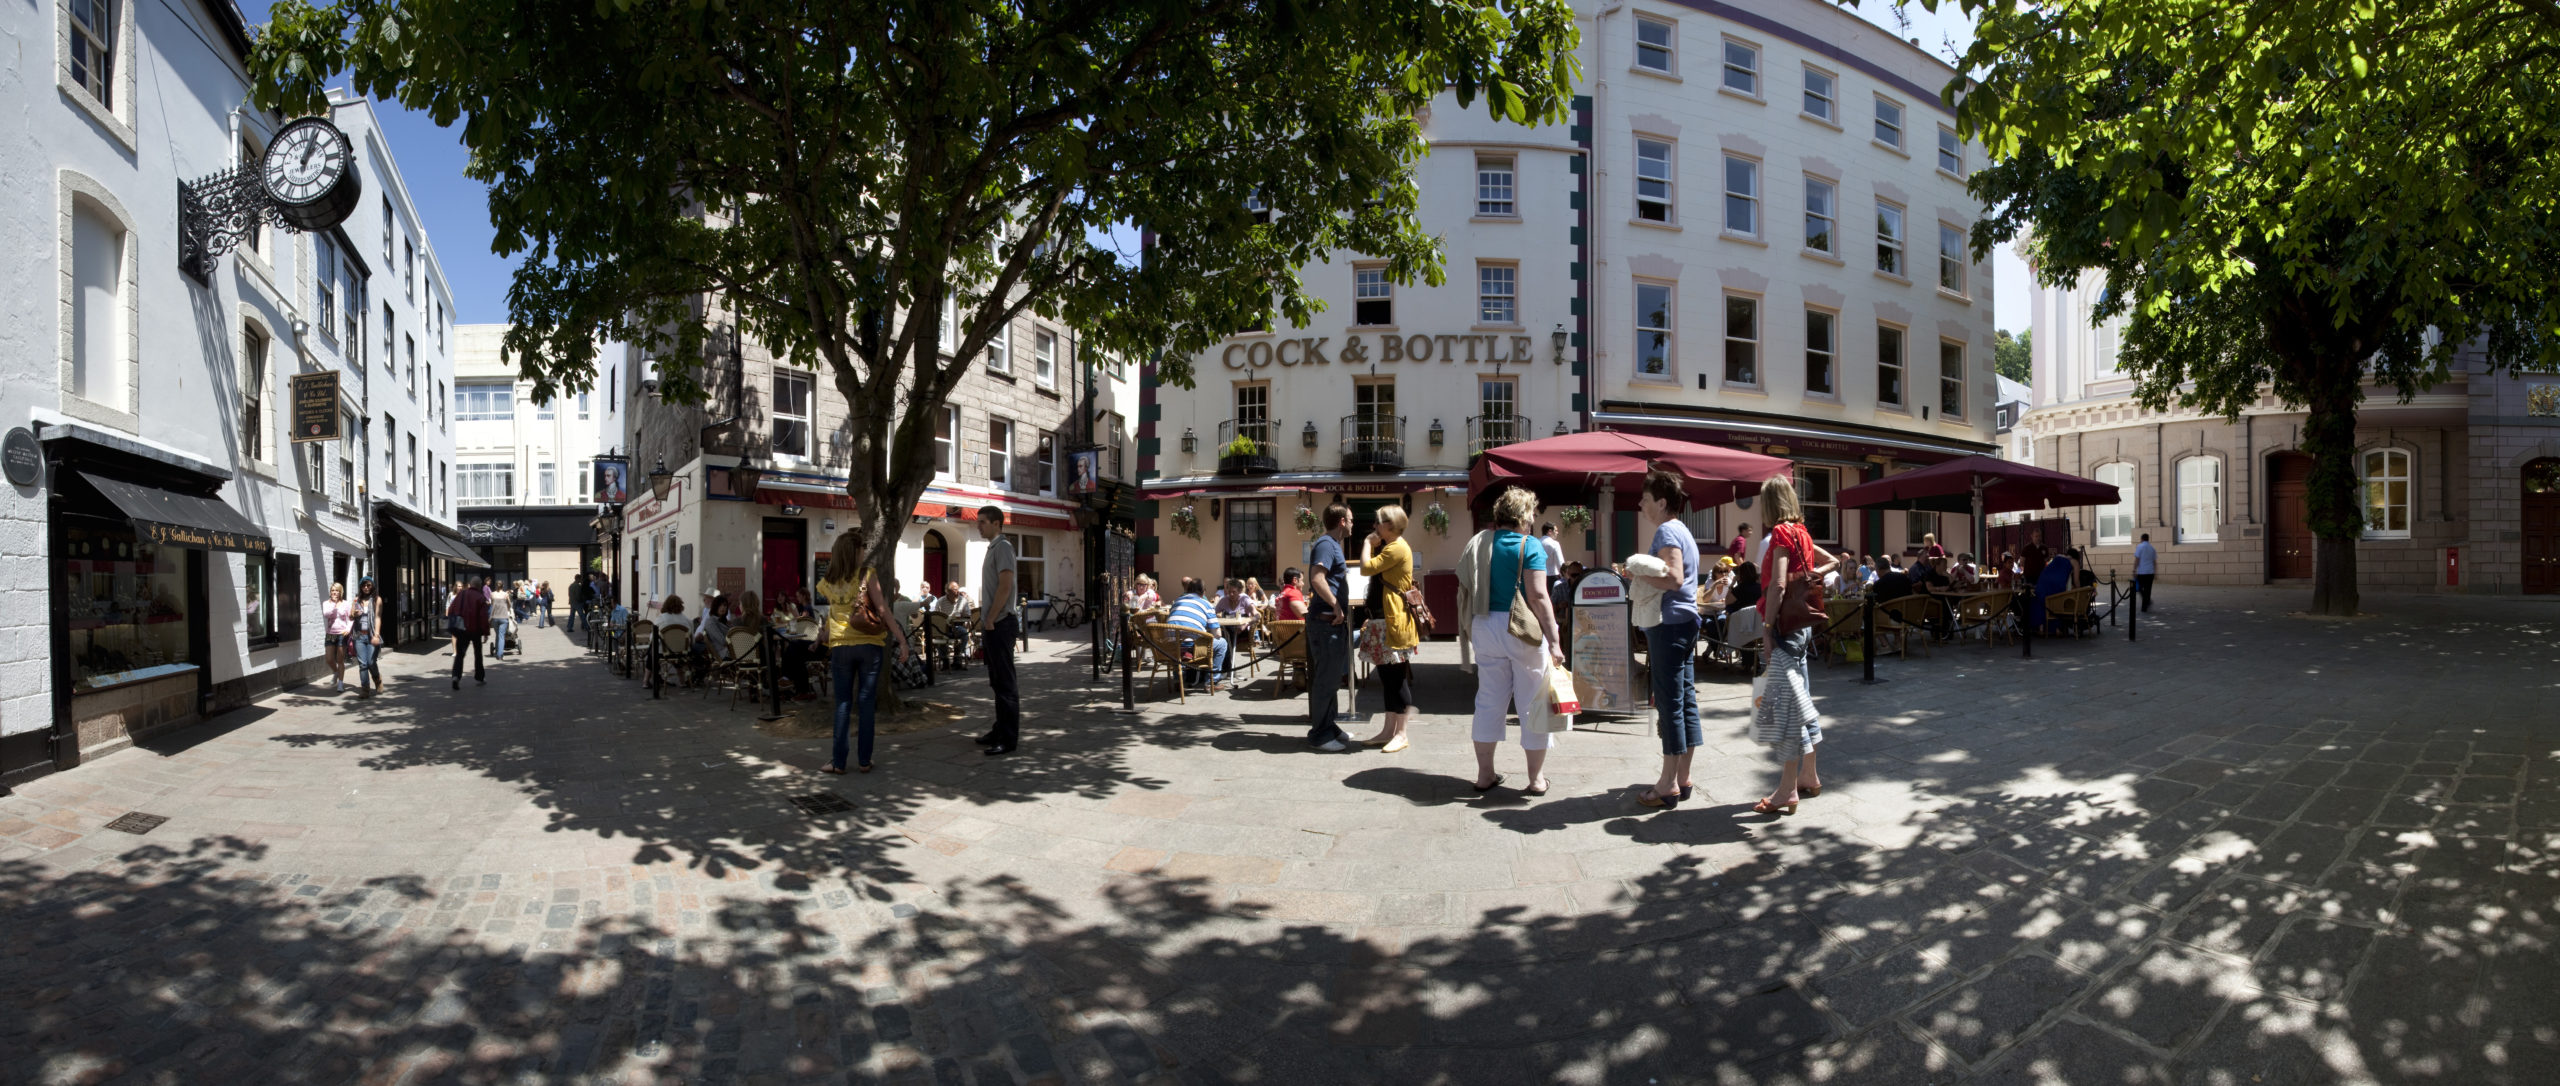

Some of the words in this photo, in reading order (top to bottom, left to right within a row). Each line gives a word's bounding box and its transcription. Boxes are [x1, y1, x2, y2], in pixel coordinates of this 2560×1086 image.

[1223, 337, 1329, 371] COCK
[1340, 335, 1368, 363] &
[1381, 334, 1533, 364] BOTTLE
[1728, 433, 1758, 442] Traditional
[1801, 439, 1819, 448] COCK
[1826, 442, 1848, 451] BOTTLE
[1355, 484, 1386, 492] BOTTLE
[169, 528, 206, 545] Gallichan
